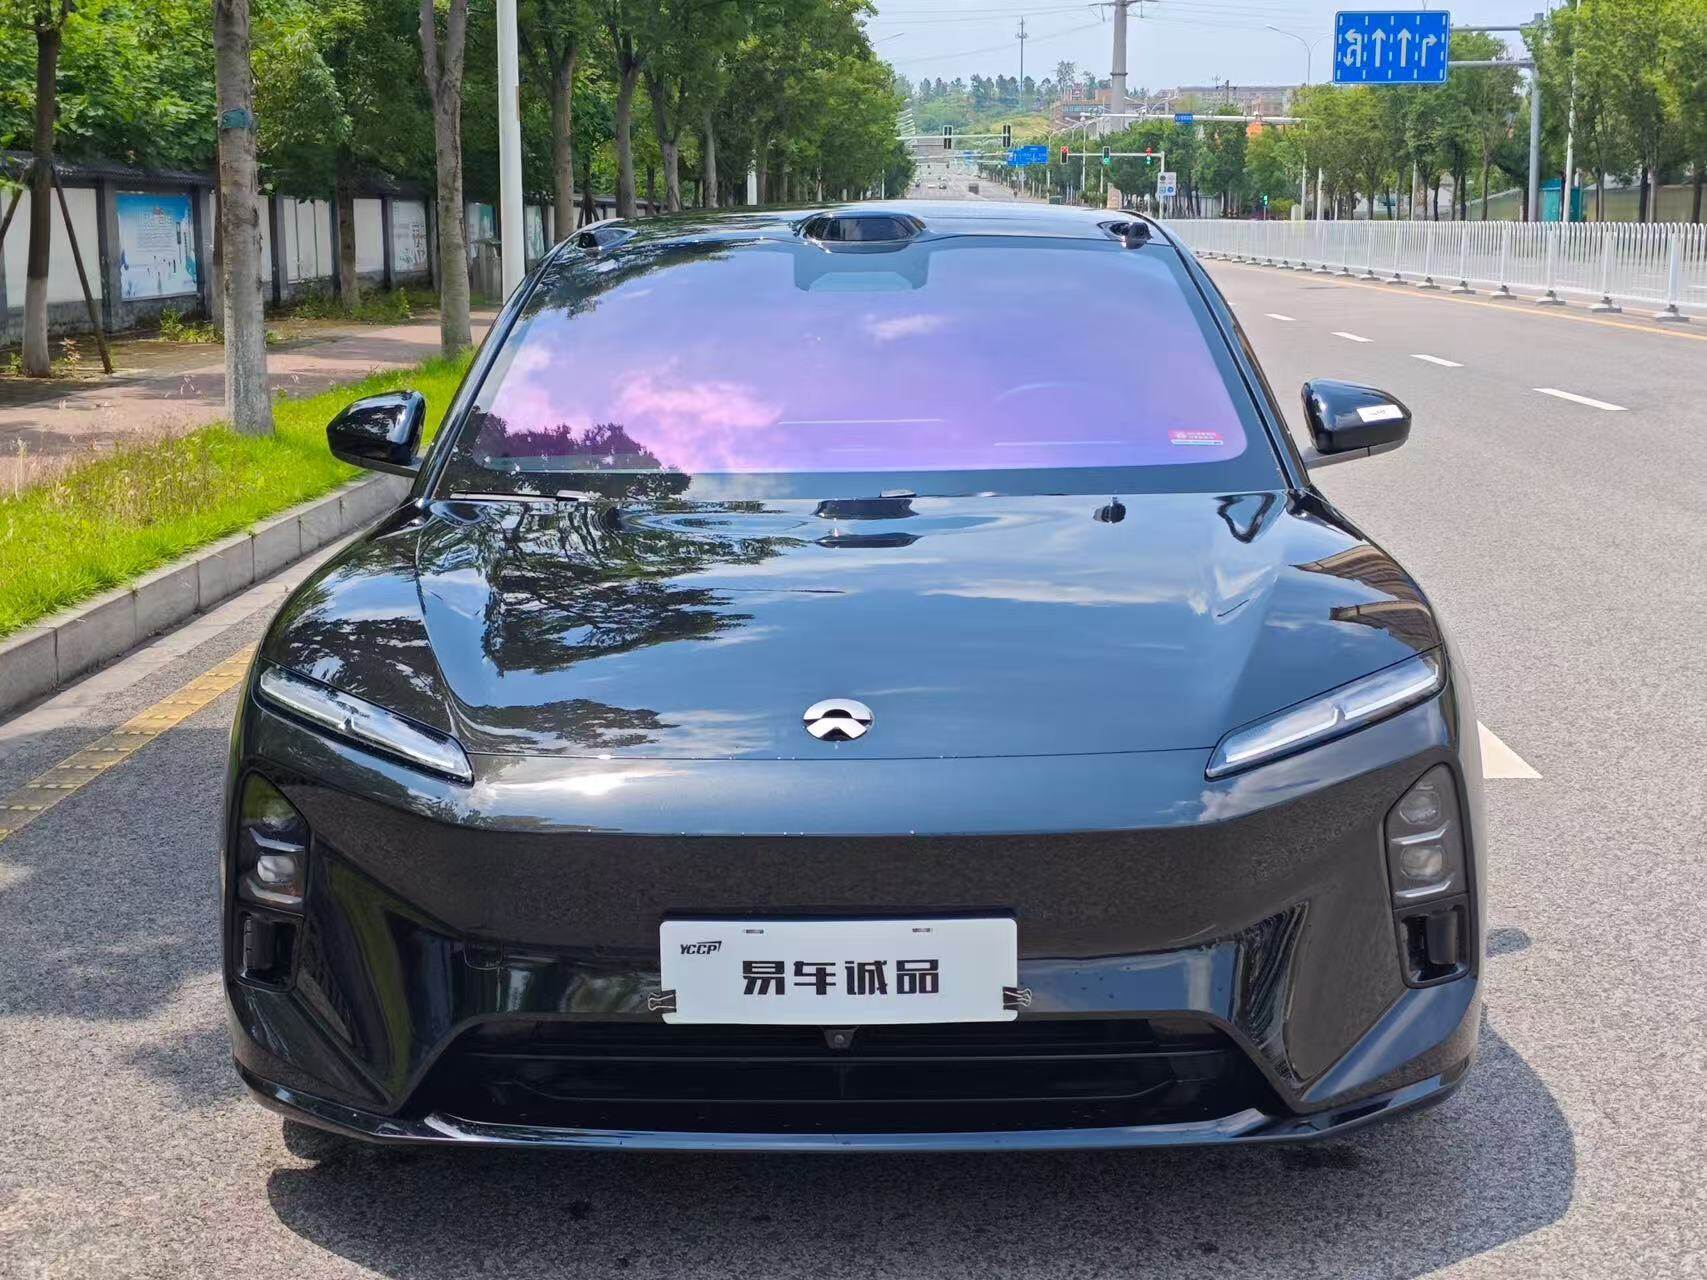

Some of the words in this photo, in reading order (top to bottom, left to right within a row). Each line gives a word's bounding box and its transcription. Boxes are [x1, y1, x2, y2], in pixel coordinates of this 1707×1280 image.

[680, 941, 721, 955] YCCP
[743, 959, 939, 995] 易车诚品
